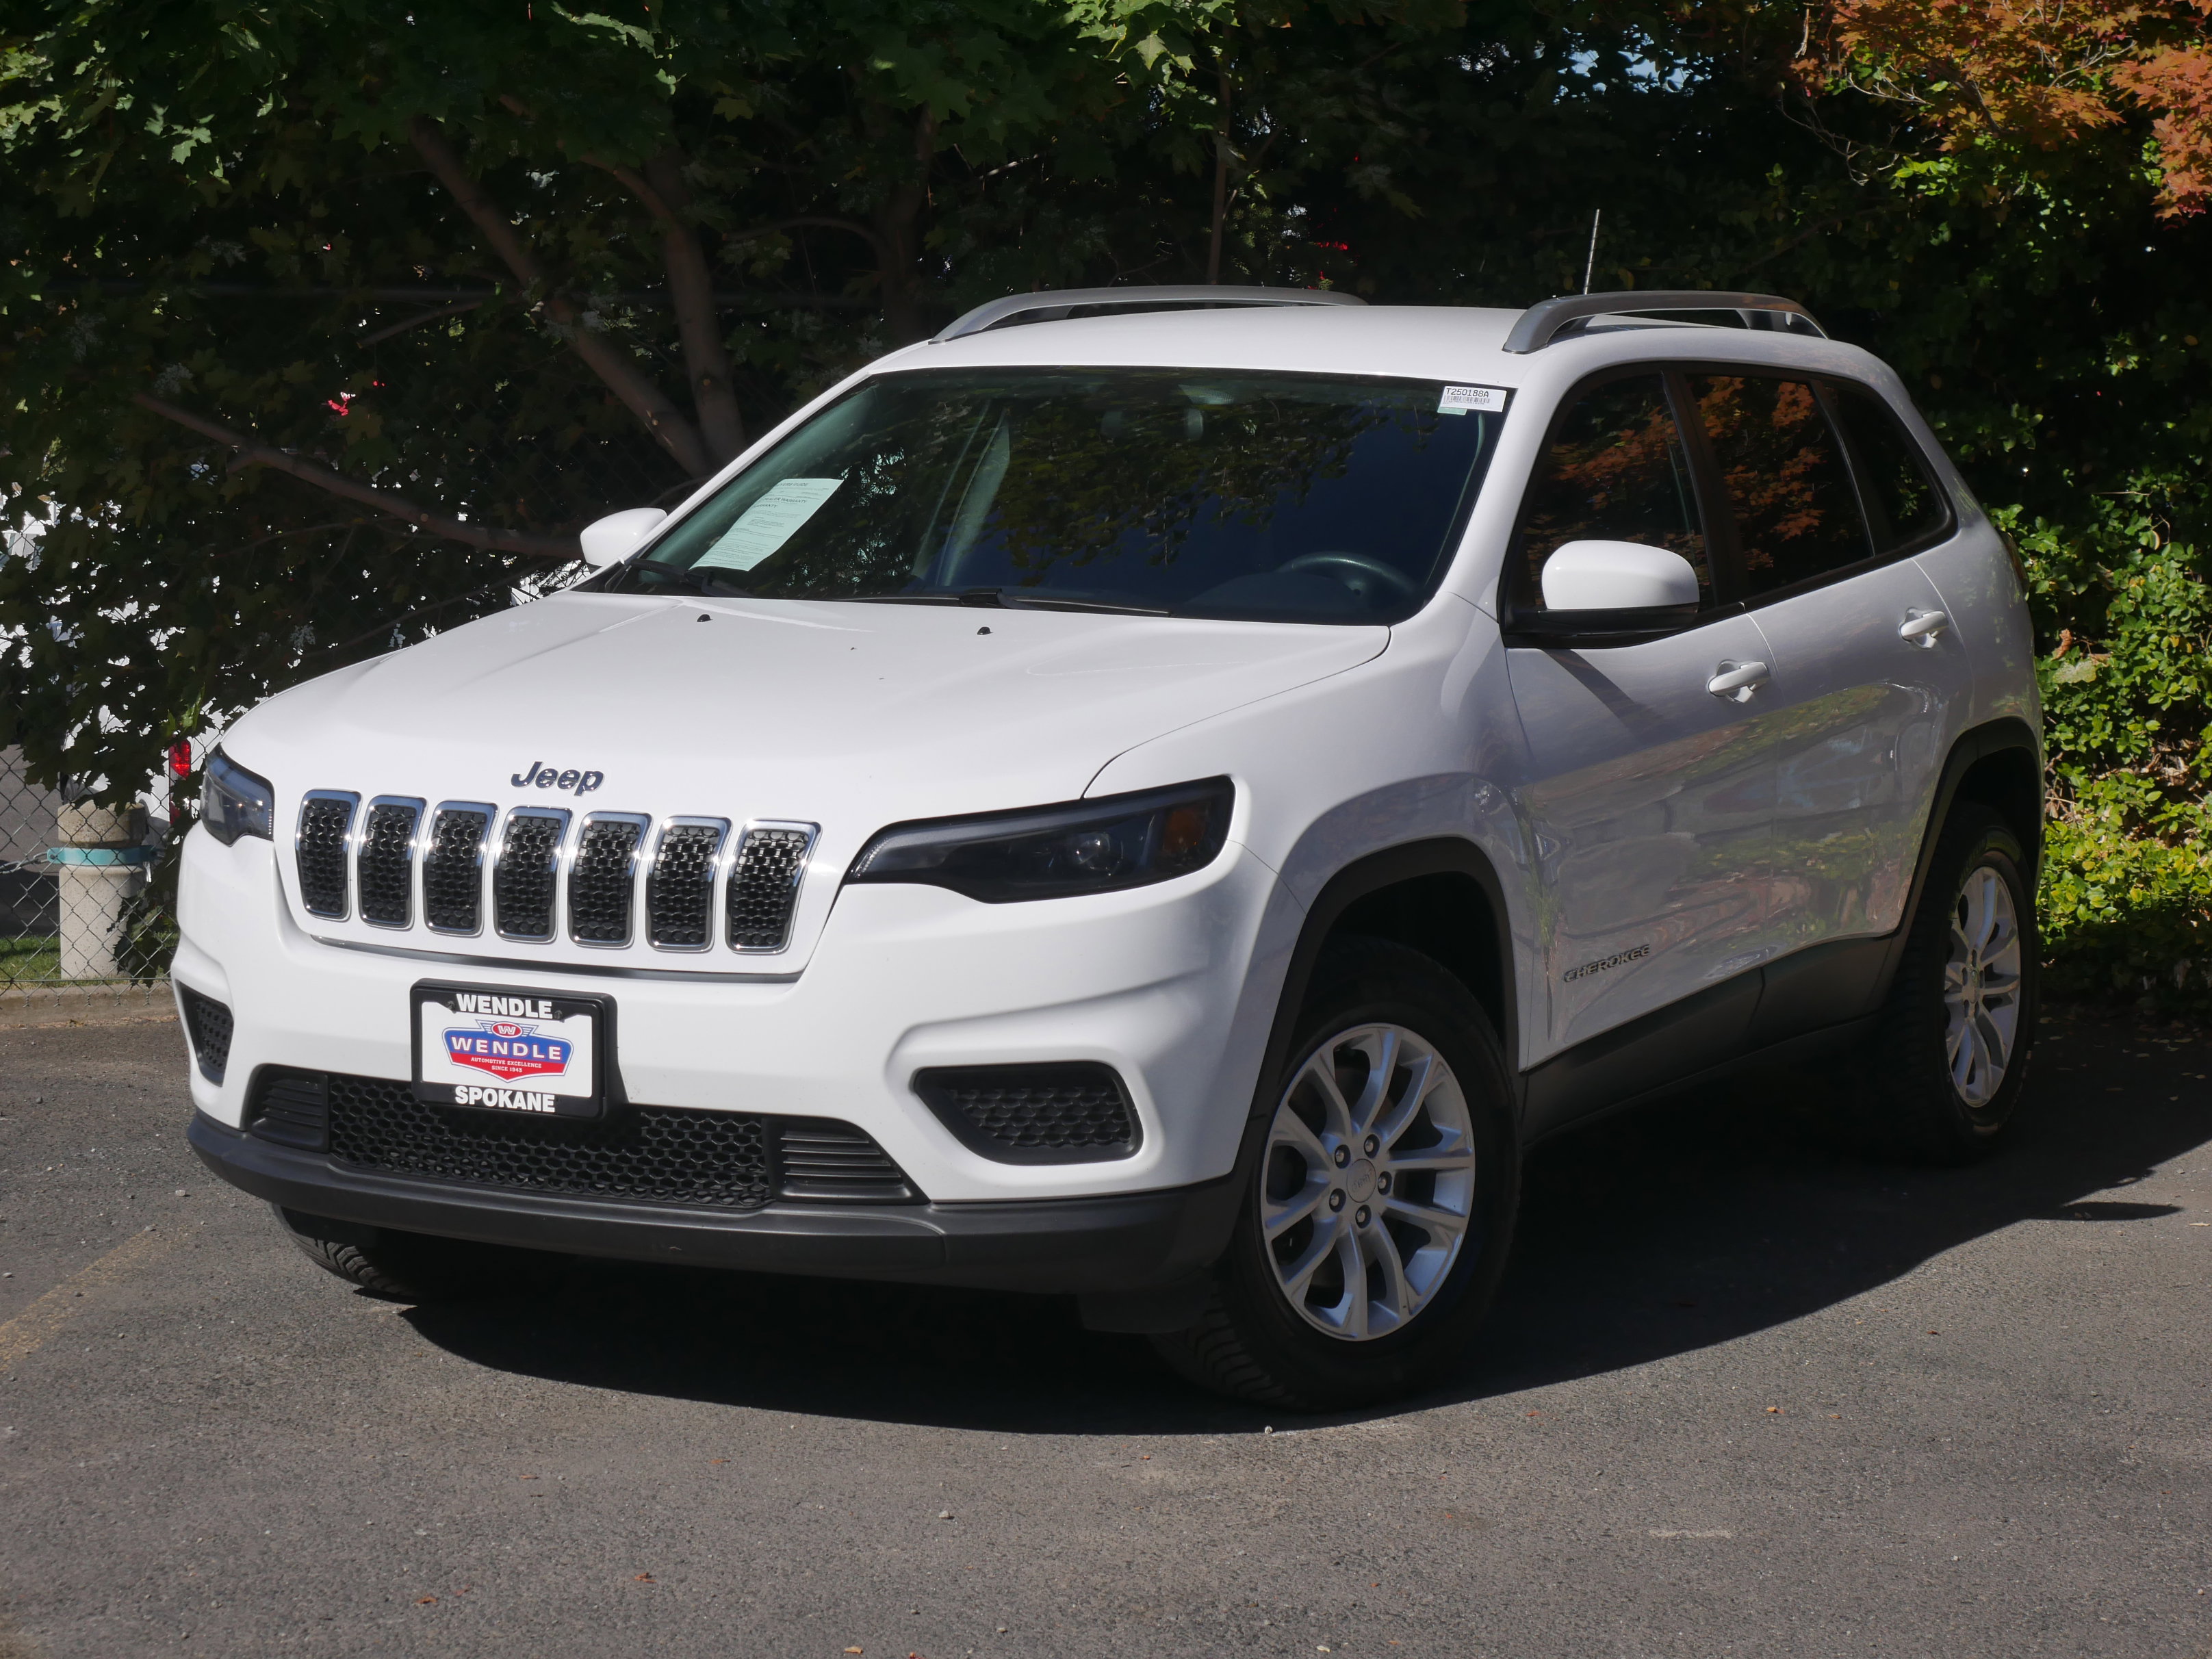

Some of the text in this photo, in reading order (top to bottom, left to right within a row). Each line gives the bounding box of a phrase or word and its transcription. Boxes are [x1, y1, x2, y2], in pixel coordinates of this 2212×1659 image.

[1446, 387, 1489, 398] T250188A
[511, 761, 604, 797] Jeep
[1564, 944, 1650, 982] CHEROKEE
[456, 994, 553, 1019] WENDLE
[451, 1037, 561, 1060] WENDLE
[455, 1085, 556, 1113] SPOKANE
